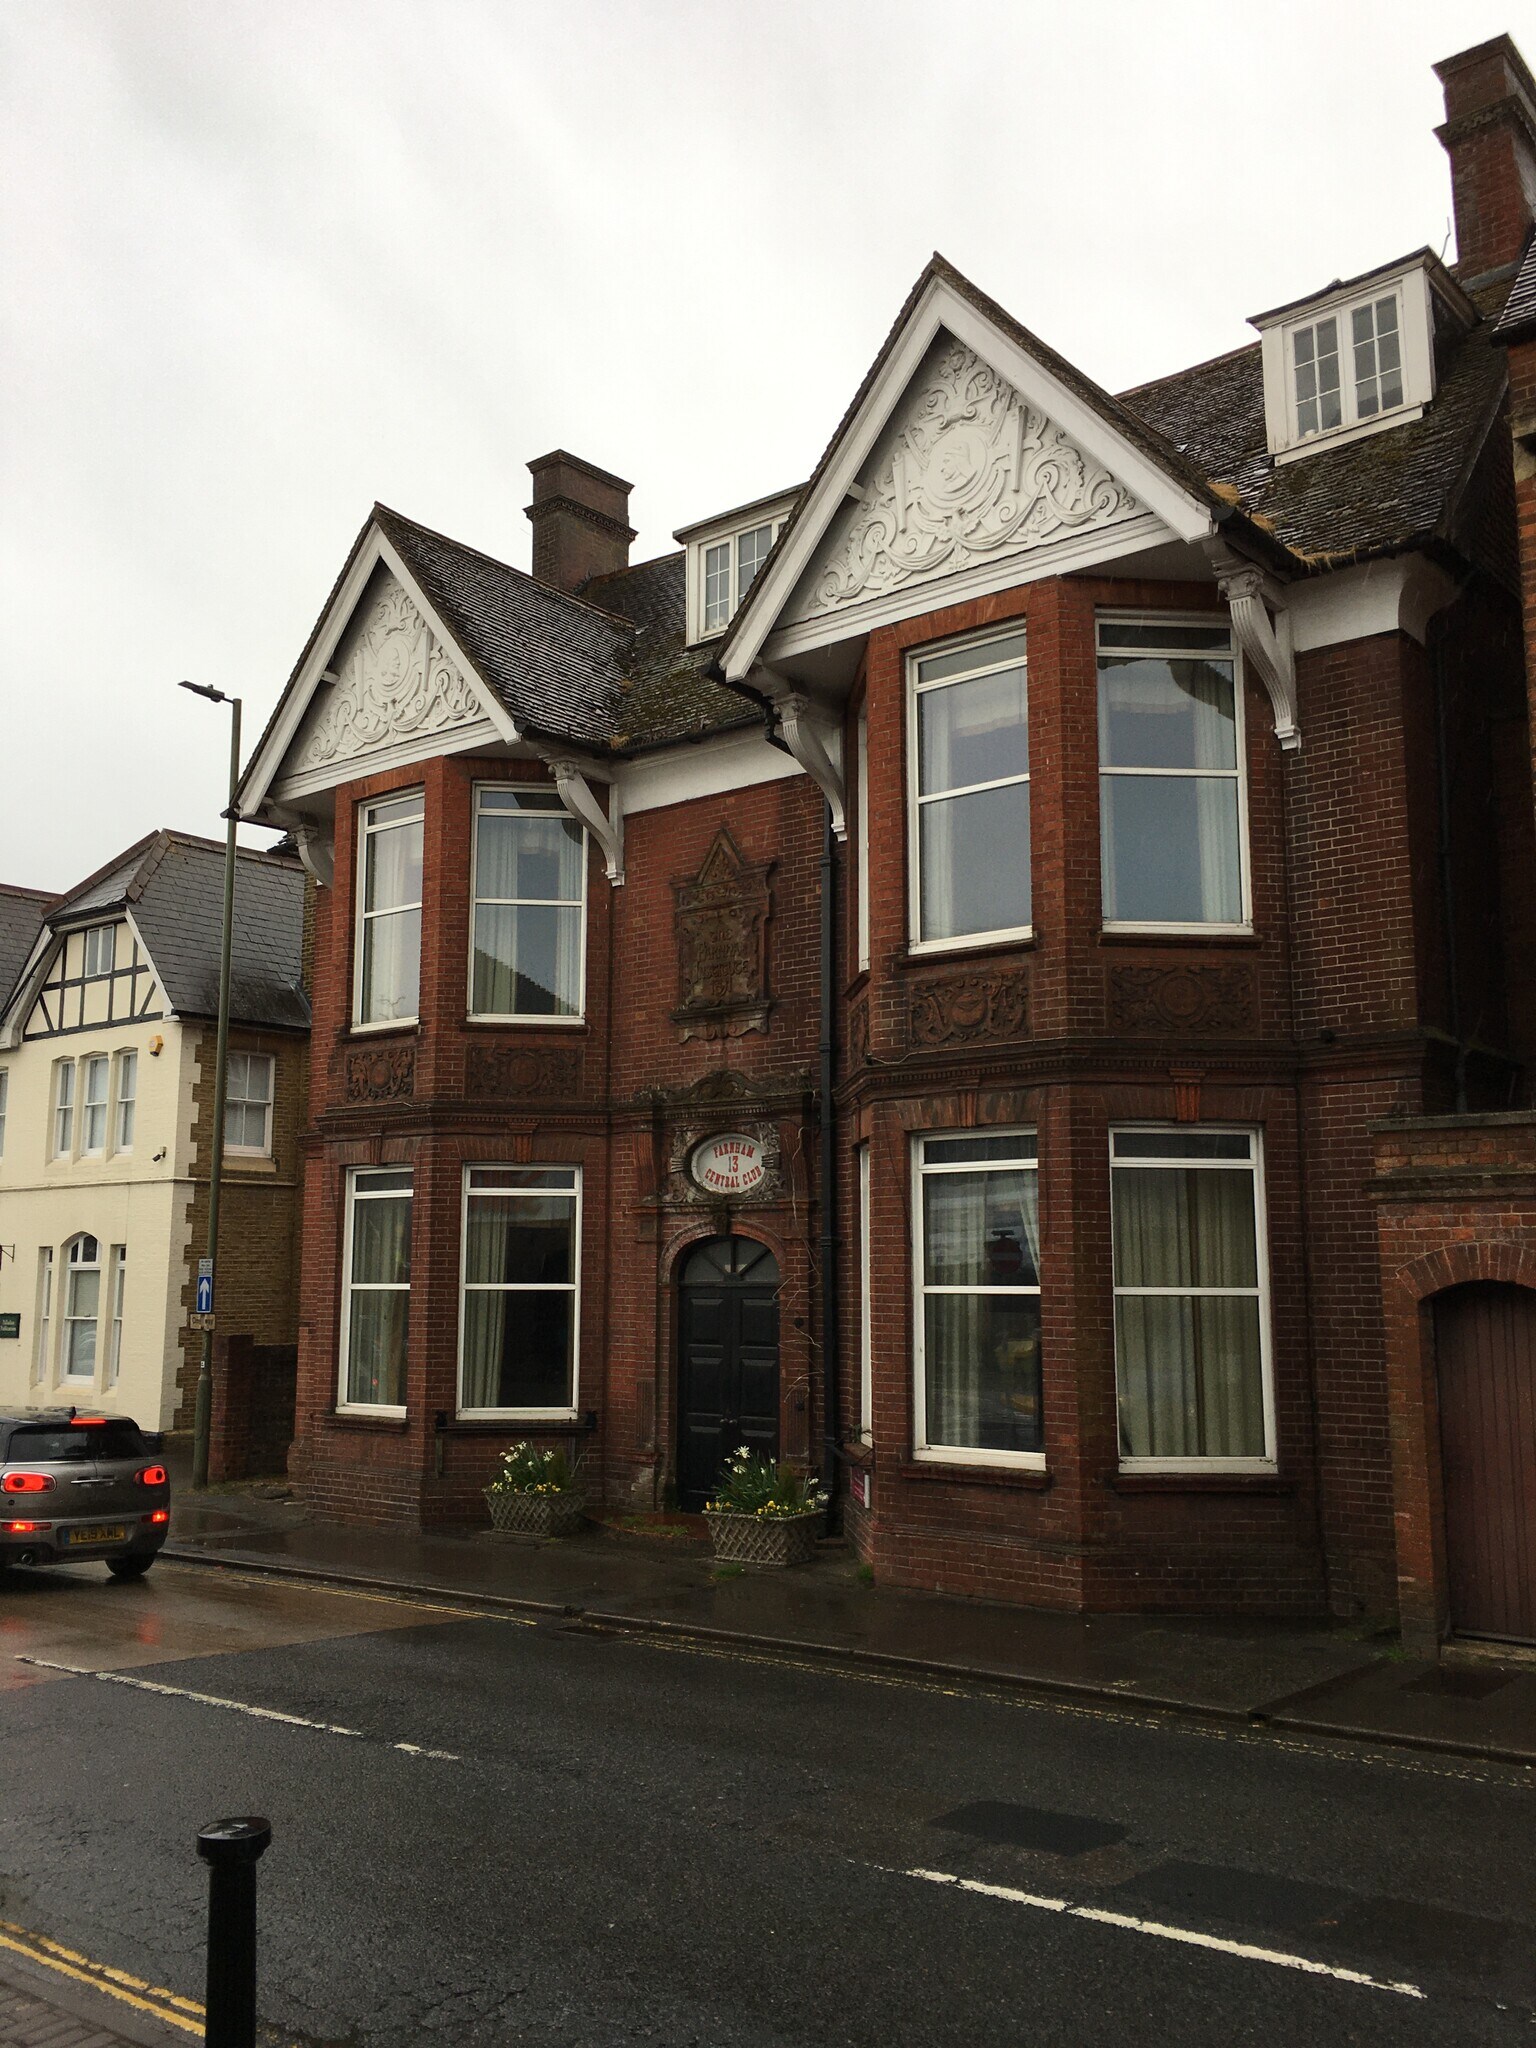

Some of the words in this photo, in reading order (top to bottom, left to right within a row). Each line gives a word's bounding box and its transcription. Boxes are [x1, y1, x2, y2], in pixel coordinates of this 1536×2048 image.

[713, 1142, 755, 1158] FARNHAM
[728, 1155, 739, 1173] 13
[704, 1168, 739, 1188] CENTRAL
[742, 1165, 762, 1185] CLUB
